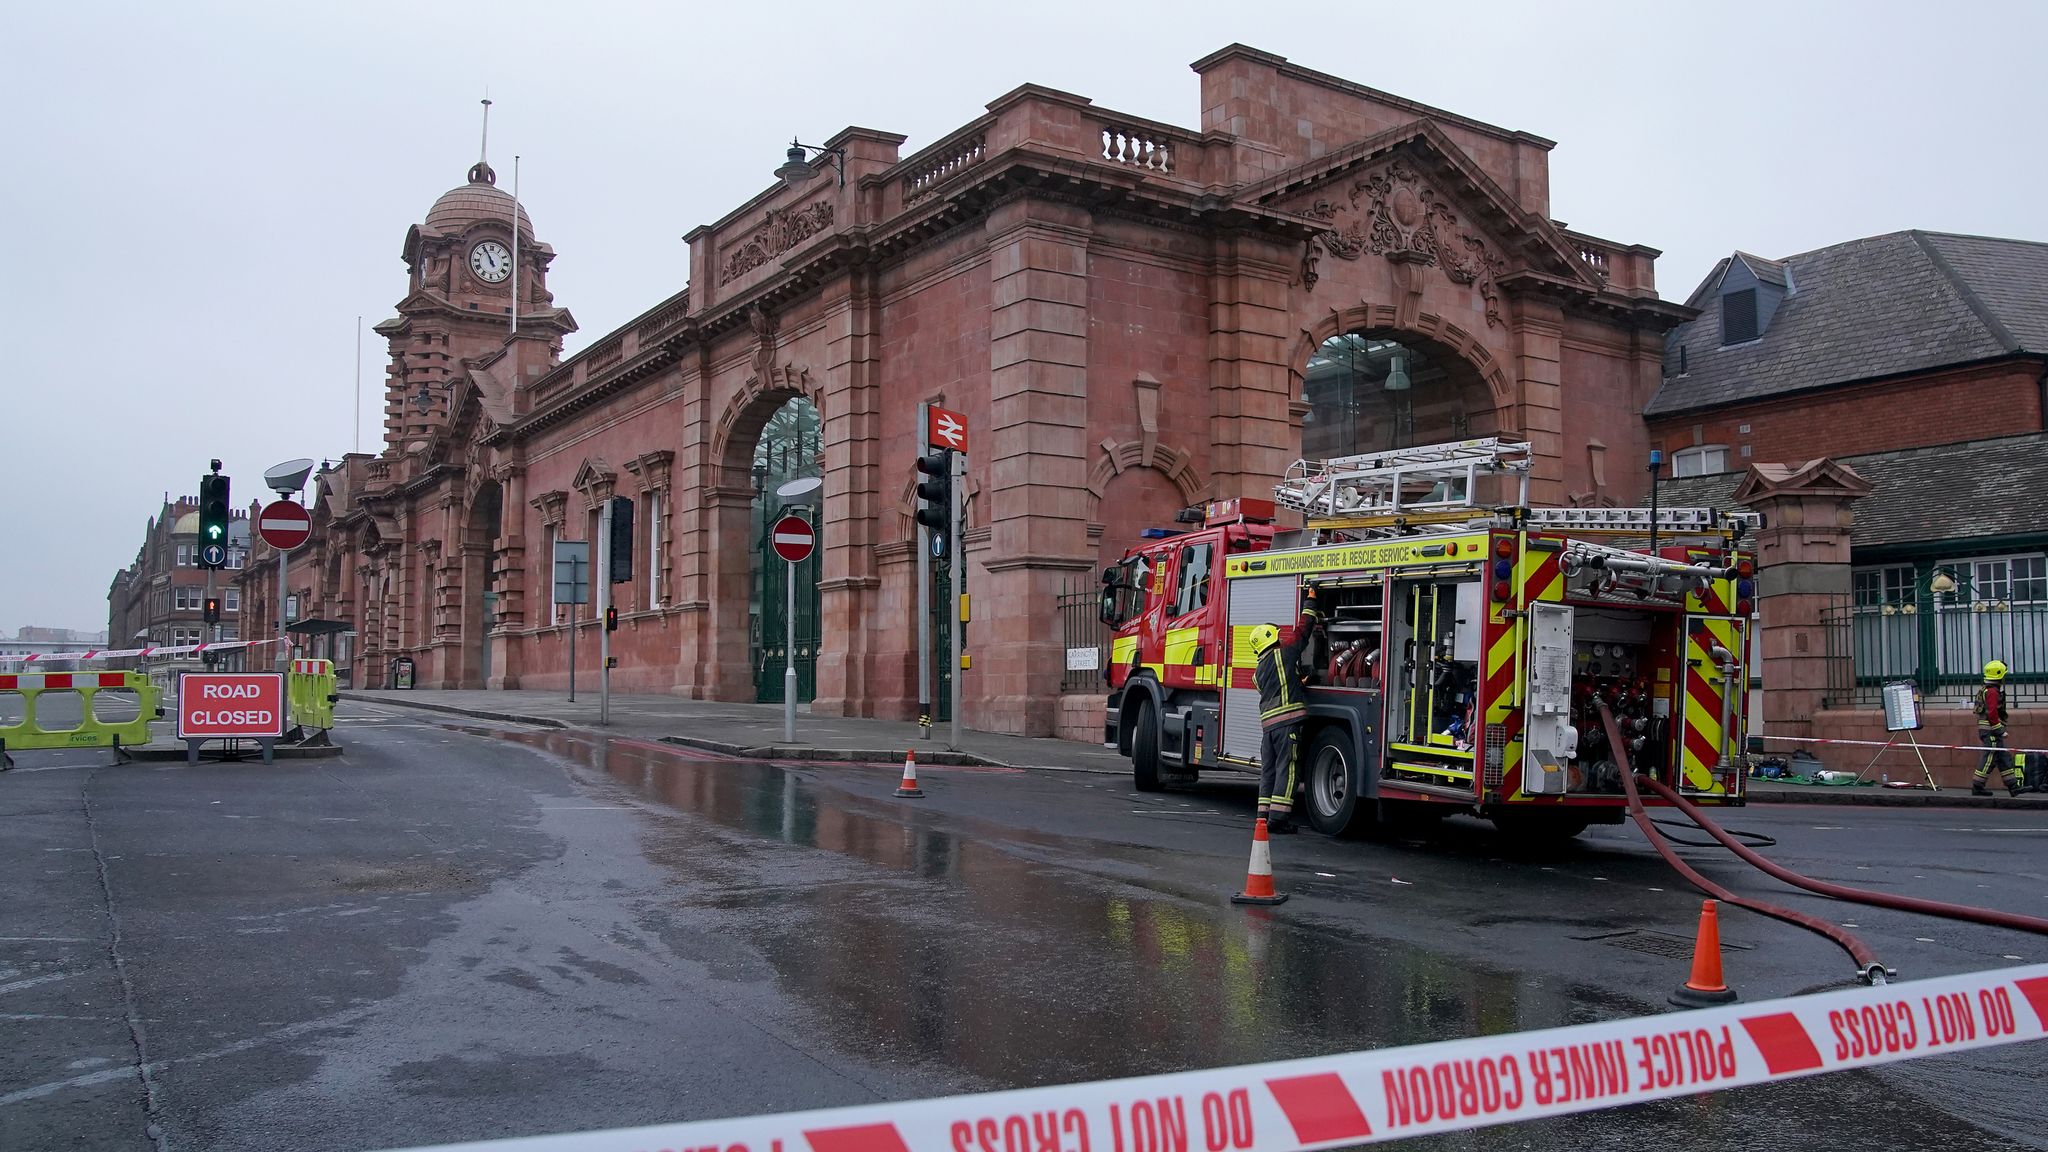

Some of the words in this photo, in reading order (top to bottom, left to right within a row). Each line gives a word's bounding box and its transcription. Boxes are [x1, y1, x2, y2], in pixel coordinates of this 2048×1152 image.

[1270, 554, 1324, 571] NOTTINGHAMSHIRE
[1326, 552, 1340, 567] FIRE
[1342, 551, 1347, 565] &
[1350, 549, 1376, 565] RESCUE
[1379, 546, 1410, 562] SERVICE
[191, 710, 272, 725] CLOSED
[203, 684, 261, 699] ROAD
[1829, 1001, 1917, 1061] CROSS
[1922, 992, 1976, 1046] NOT
[1978, 986, 2015, 1037] DO
[1528, 1040, 1629, 1105] INNER
[1633, 1025, 1736, 1091] POLICE
[1202, 1088, 1254, 1151] DO
[1382, 1054, 1524, 1128] CORDON
